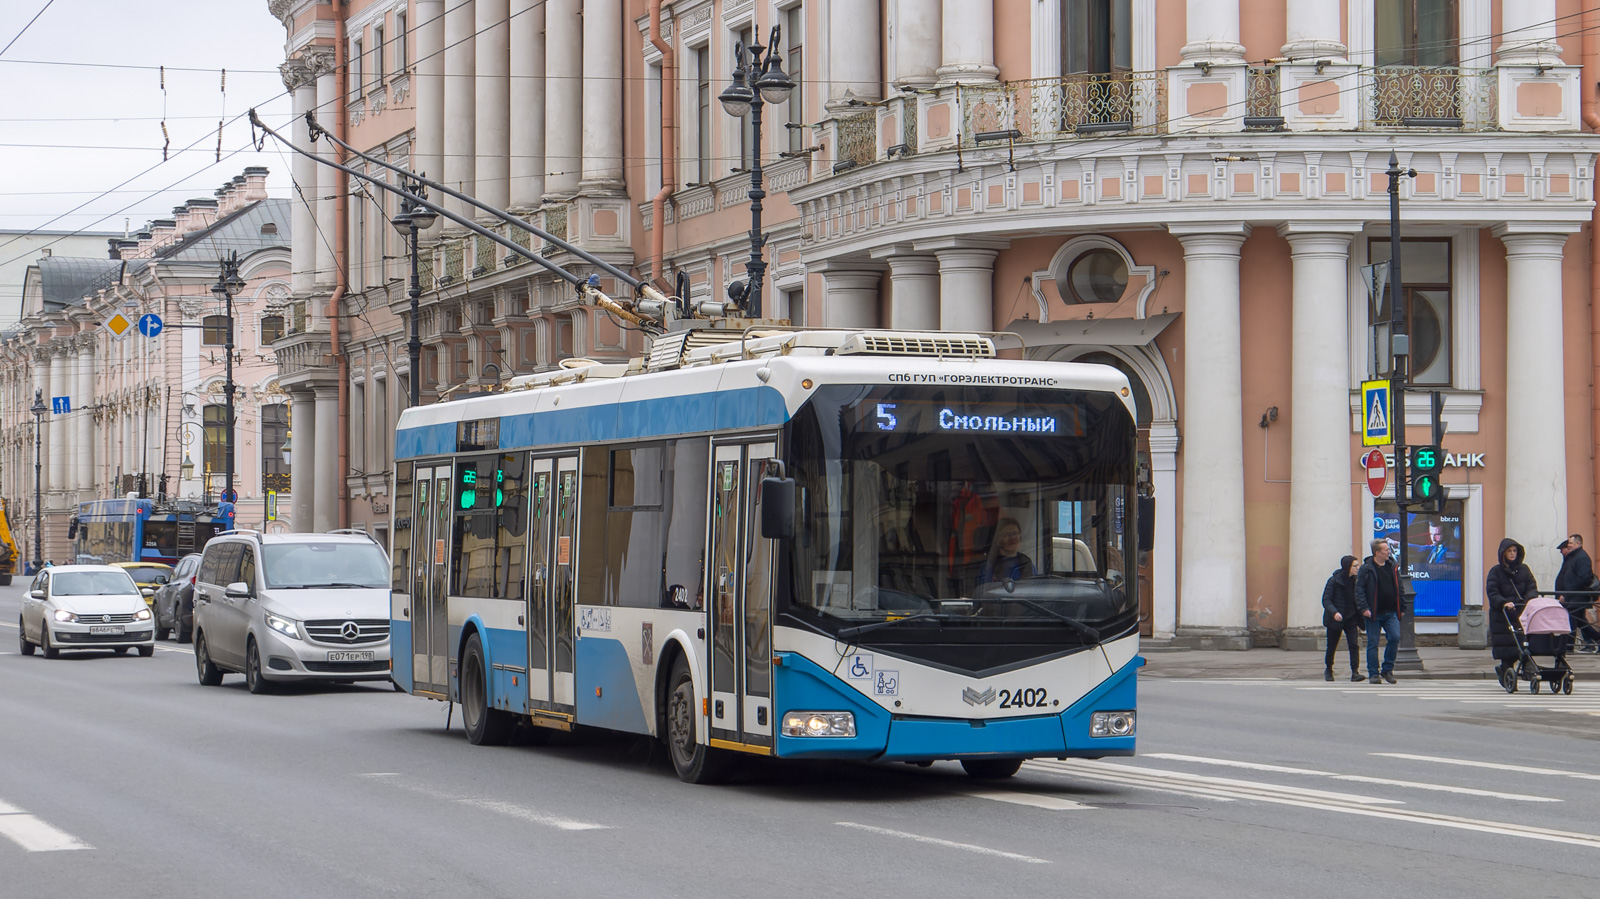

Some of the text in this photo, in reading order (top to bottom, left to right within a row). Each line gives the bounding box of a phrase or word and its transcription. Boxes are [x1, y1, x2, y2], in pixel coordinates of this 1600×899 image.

[888, 373, 1058, 387] СПб ГУП «ГОРЭЛЕКТРОТРАНС»
[876, 403, 1057, 433] 5 Смольный
[1418, 451, 1436, 468] 26
[1443, 453, 1486, 468] АНК
[674, 587, 688, 603] 2402
[999, 687, 1048, 710] 2402
